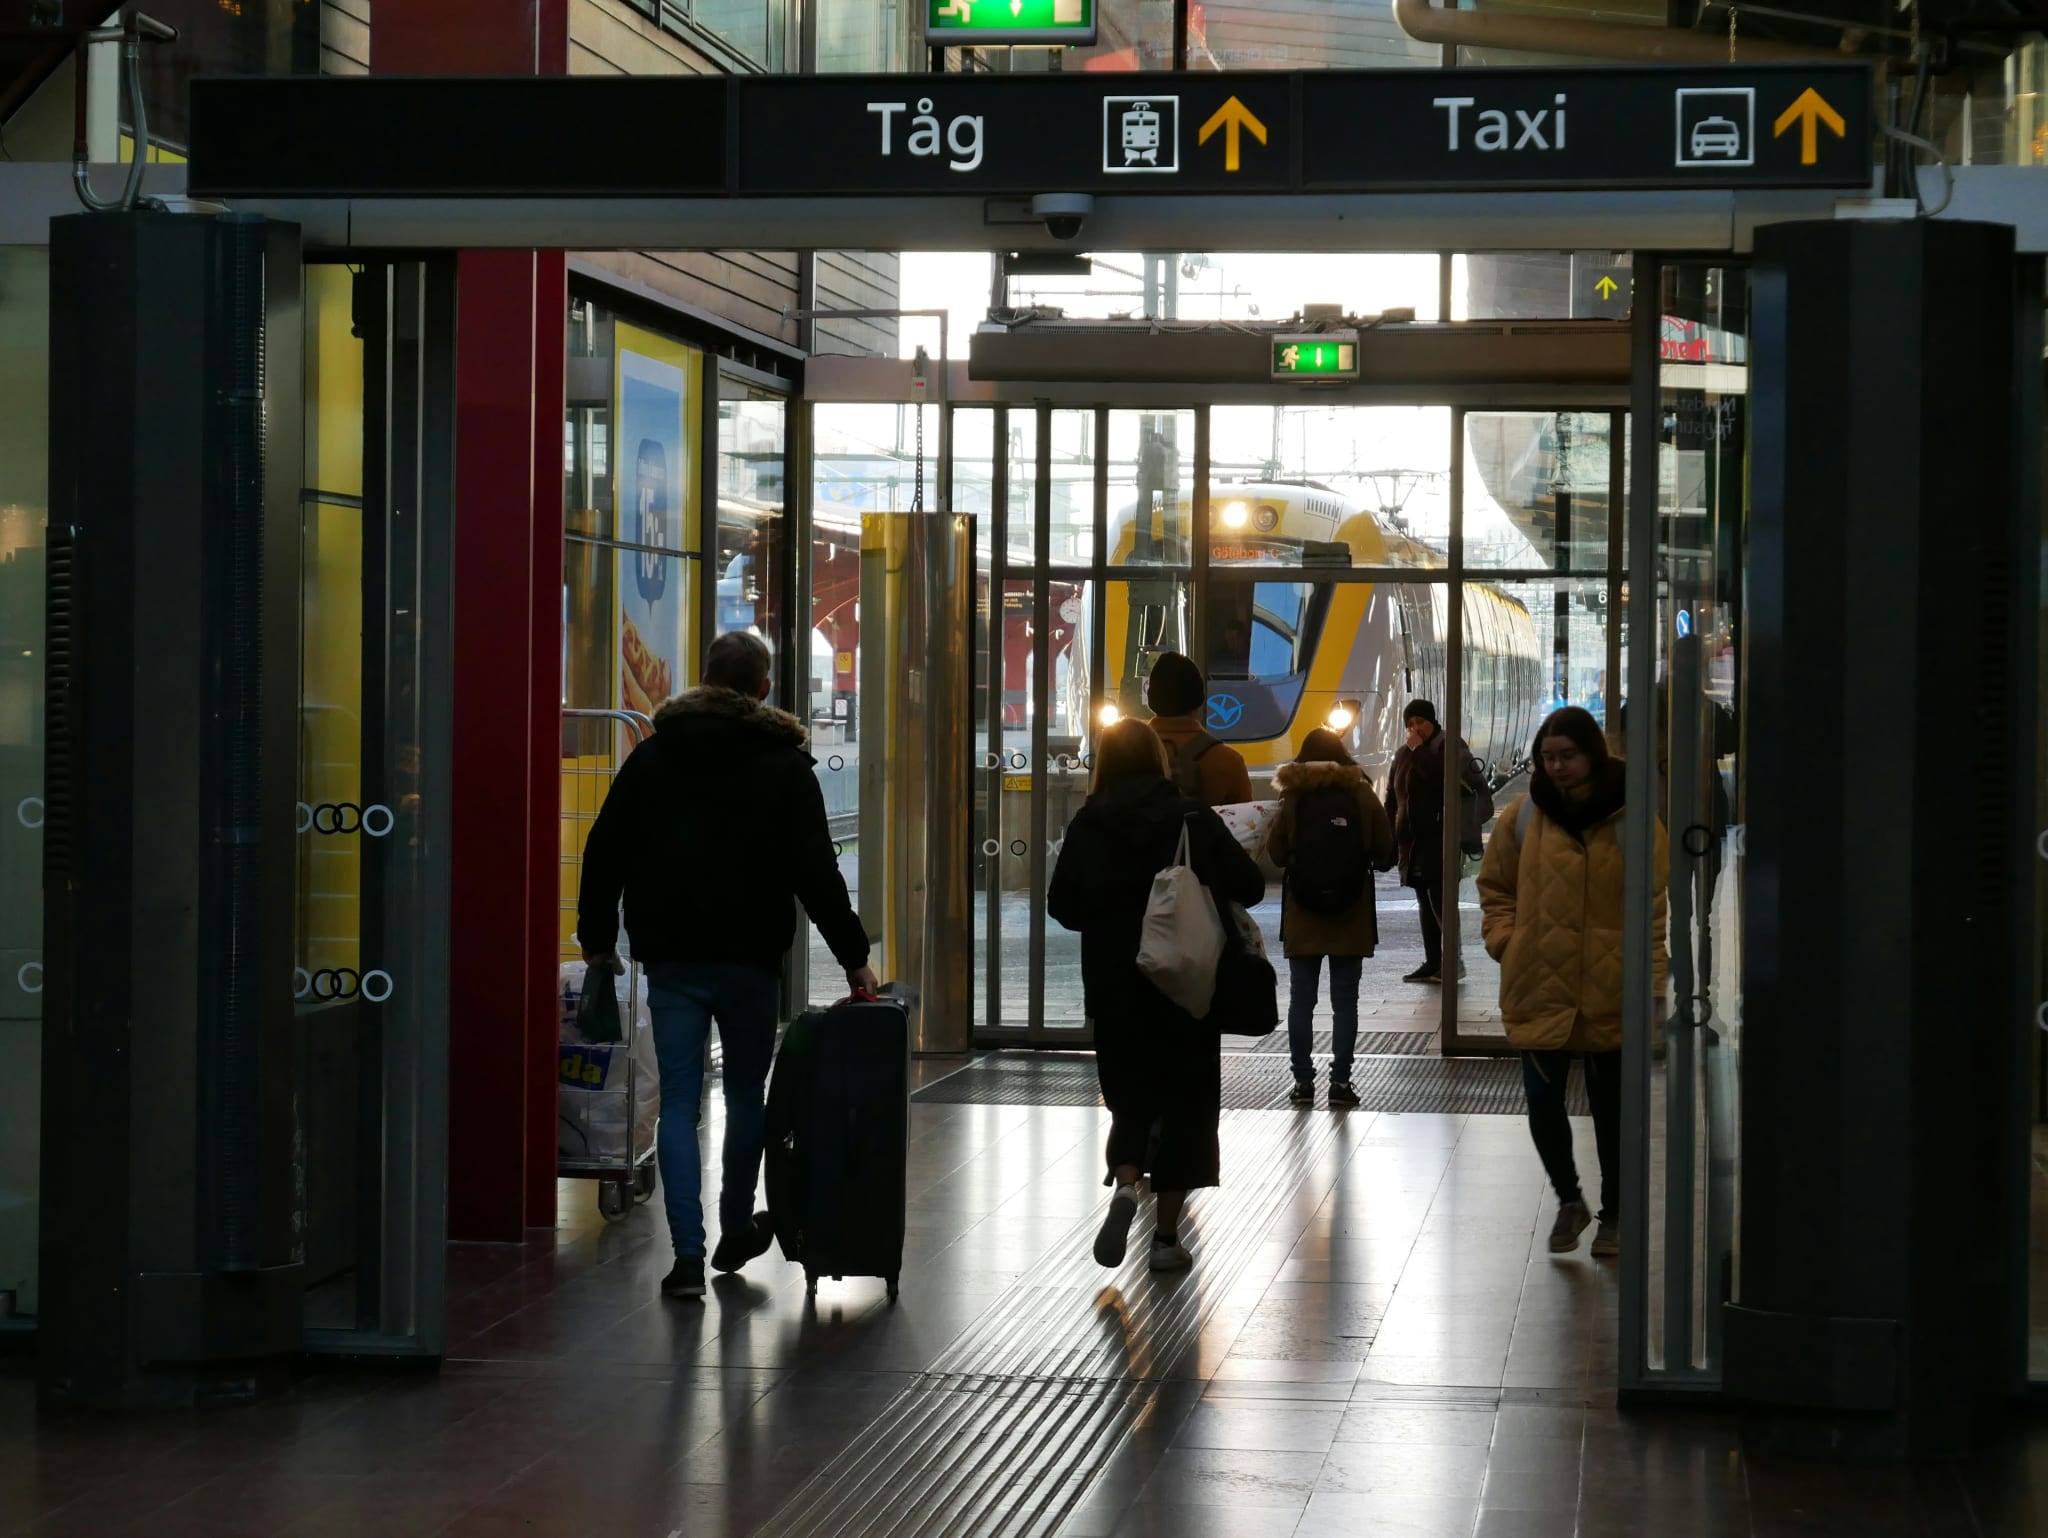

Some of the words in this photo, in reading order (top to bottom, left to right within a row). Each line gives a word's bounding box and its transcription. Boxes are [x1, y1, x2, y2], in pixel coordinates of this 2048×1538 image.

[866, 97, 984, 172] Tåg
[1432, 93, 1566, 151] Taxi
[1212, 546, 1266, 560] Göteborg
[1598, 591, 1607, 604] 6
